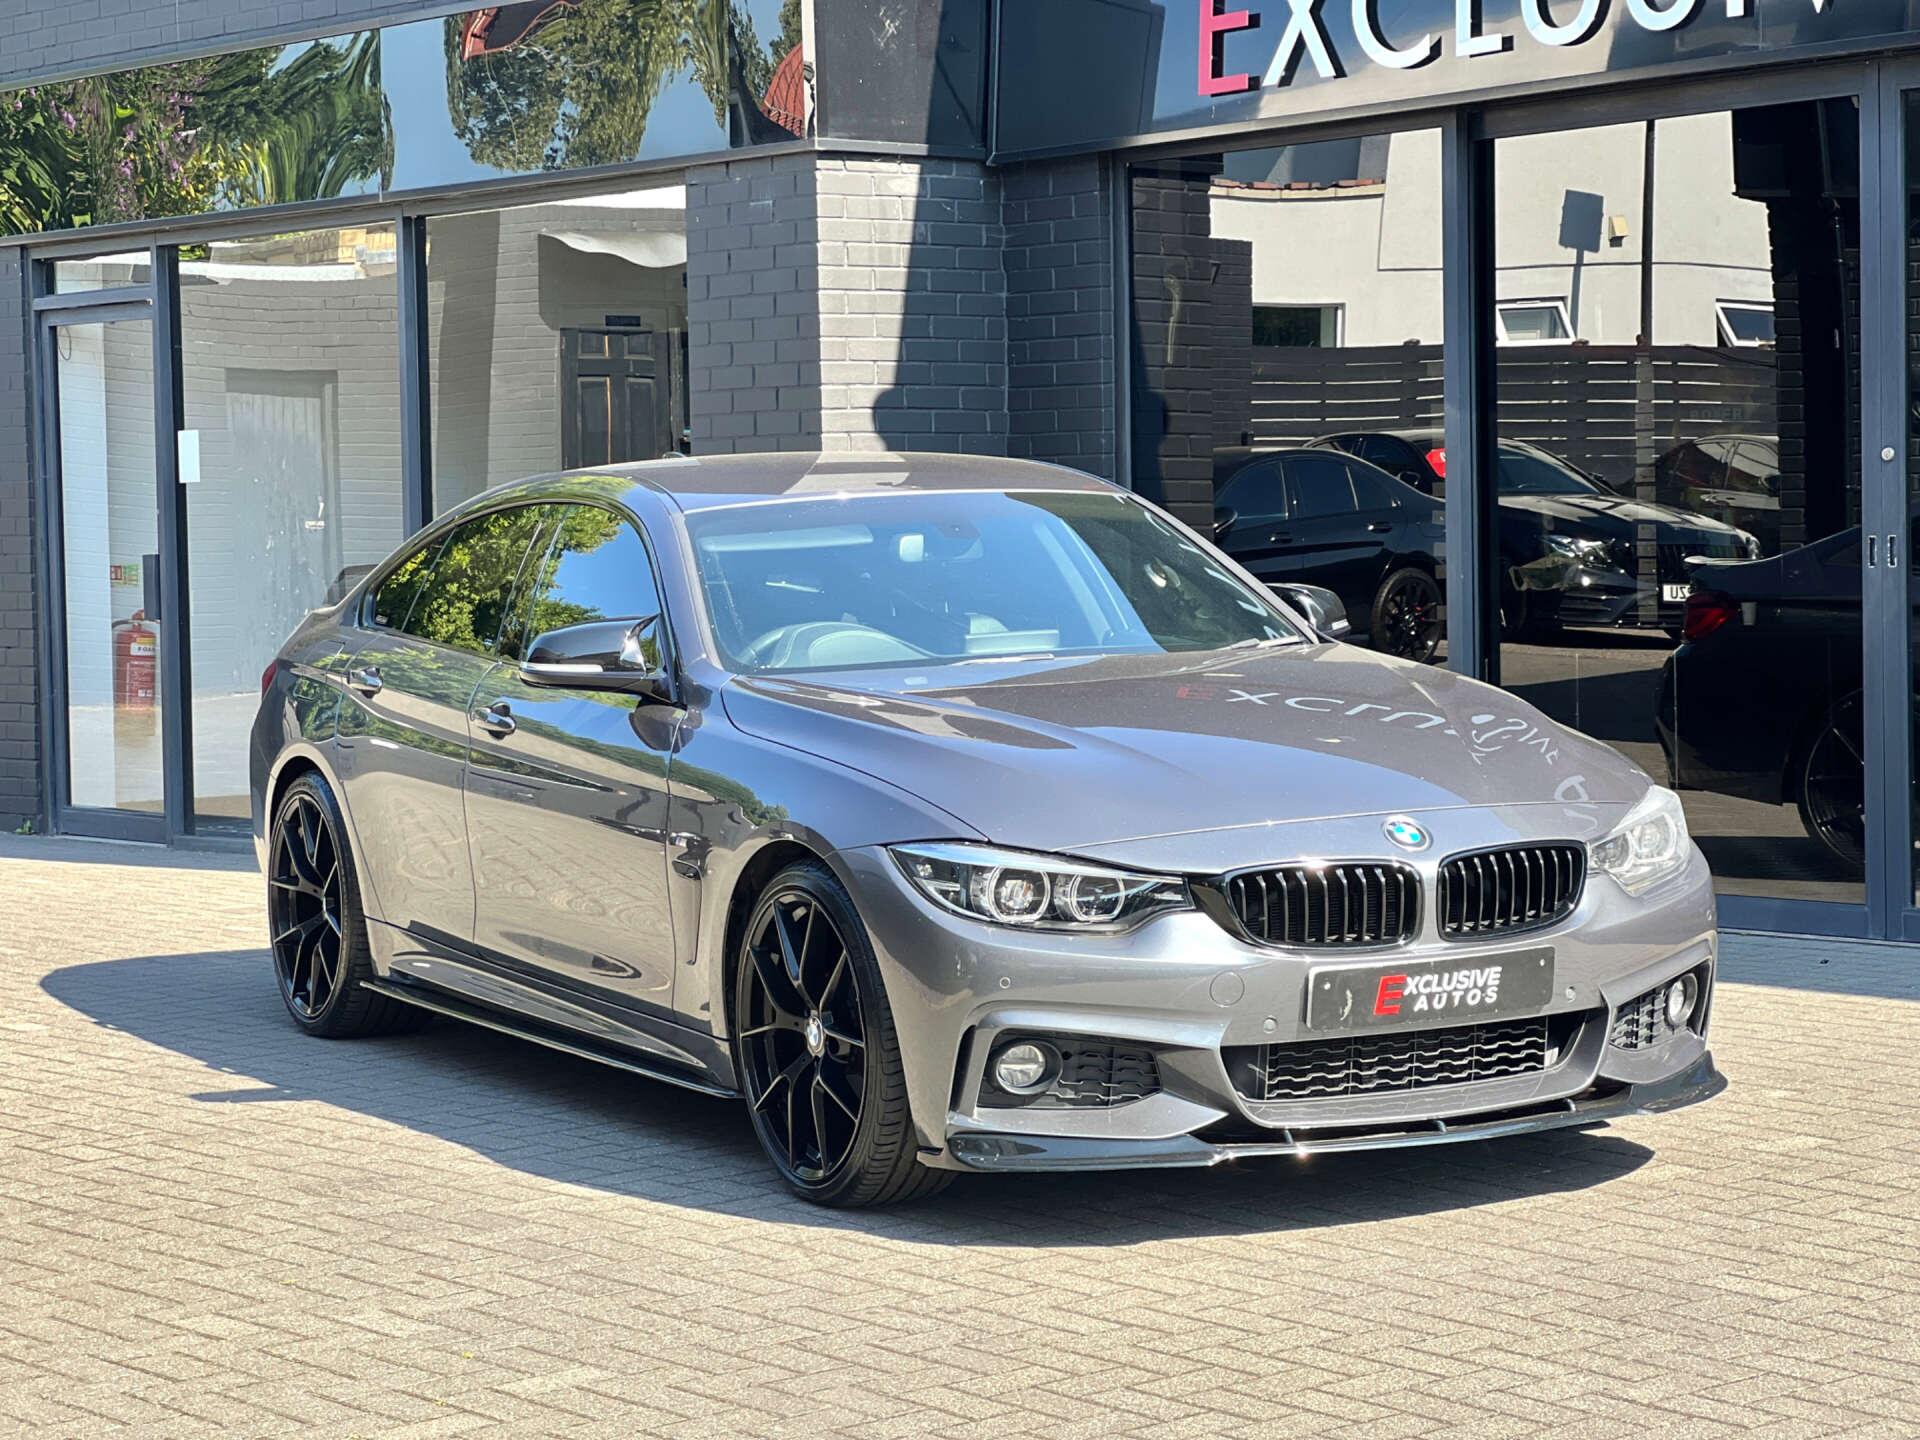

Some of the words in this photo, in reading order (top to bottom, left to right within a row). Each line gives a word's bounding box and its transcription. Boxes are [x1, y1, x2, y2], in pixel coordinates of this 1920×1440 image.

[1198, 0, 1824, 95] EXCL
[1373, 966, 1503, 1016] EXCLUSIVE
[1413, 986, 1498, 1012] AUTOS
